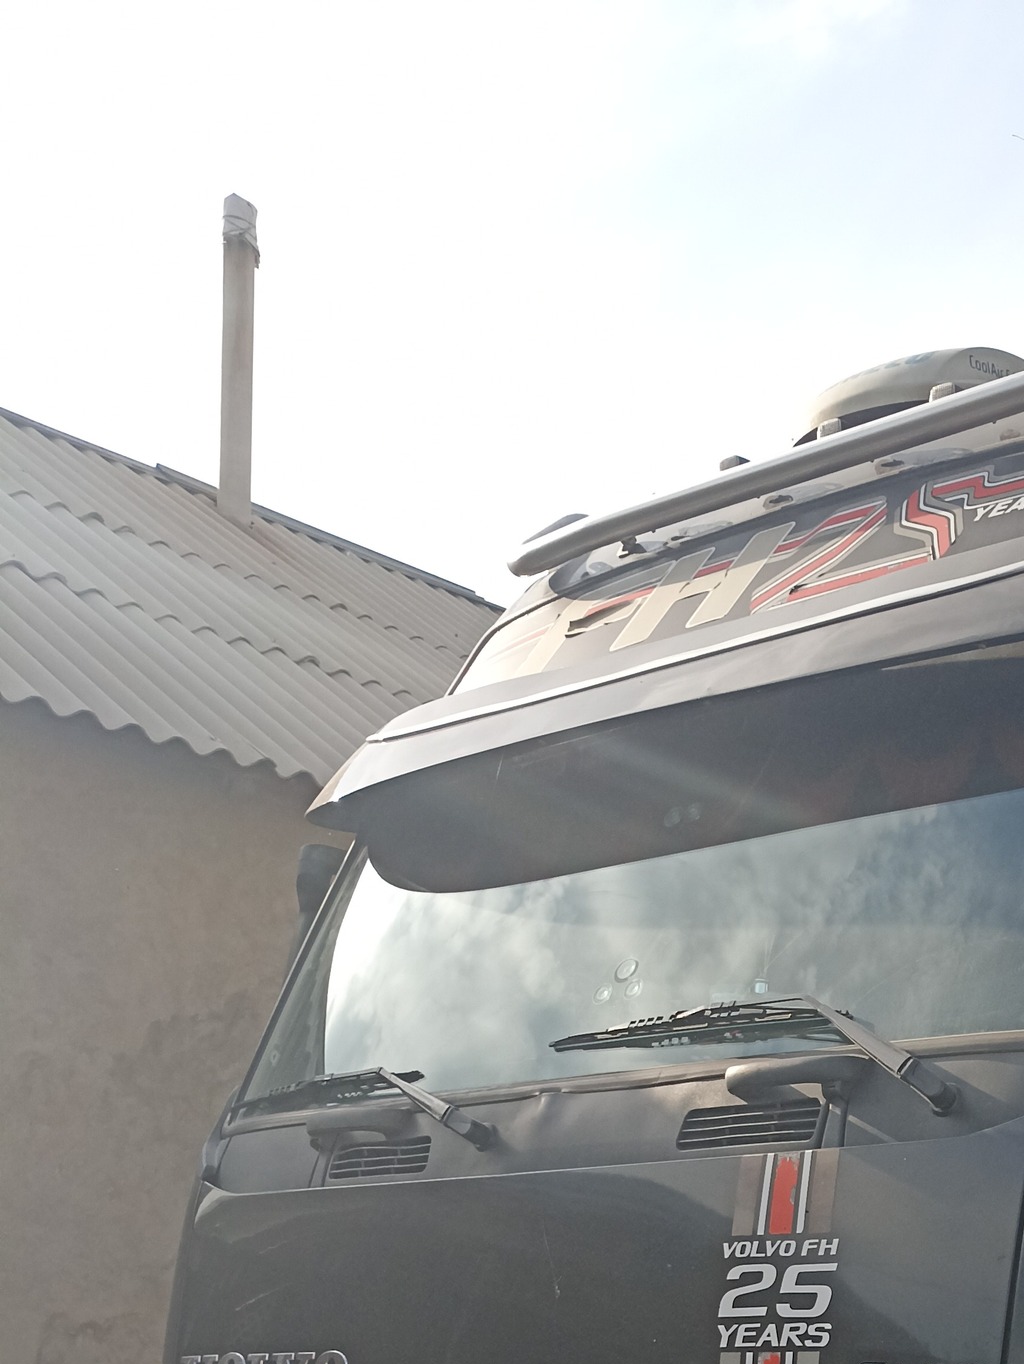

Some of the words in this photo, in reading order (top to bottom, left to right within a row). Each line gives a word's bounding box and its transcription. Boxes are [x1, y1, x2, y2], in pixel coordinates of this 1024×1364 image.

[722, 1239, 797, 1259] VOLVO
[800, 1238, 840, 1257] FH
[717, 1262, 839, 1319] 25
[717, 1322, 833, 1349] YEARS
